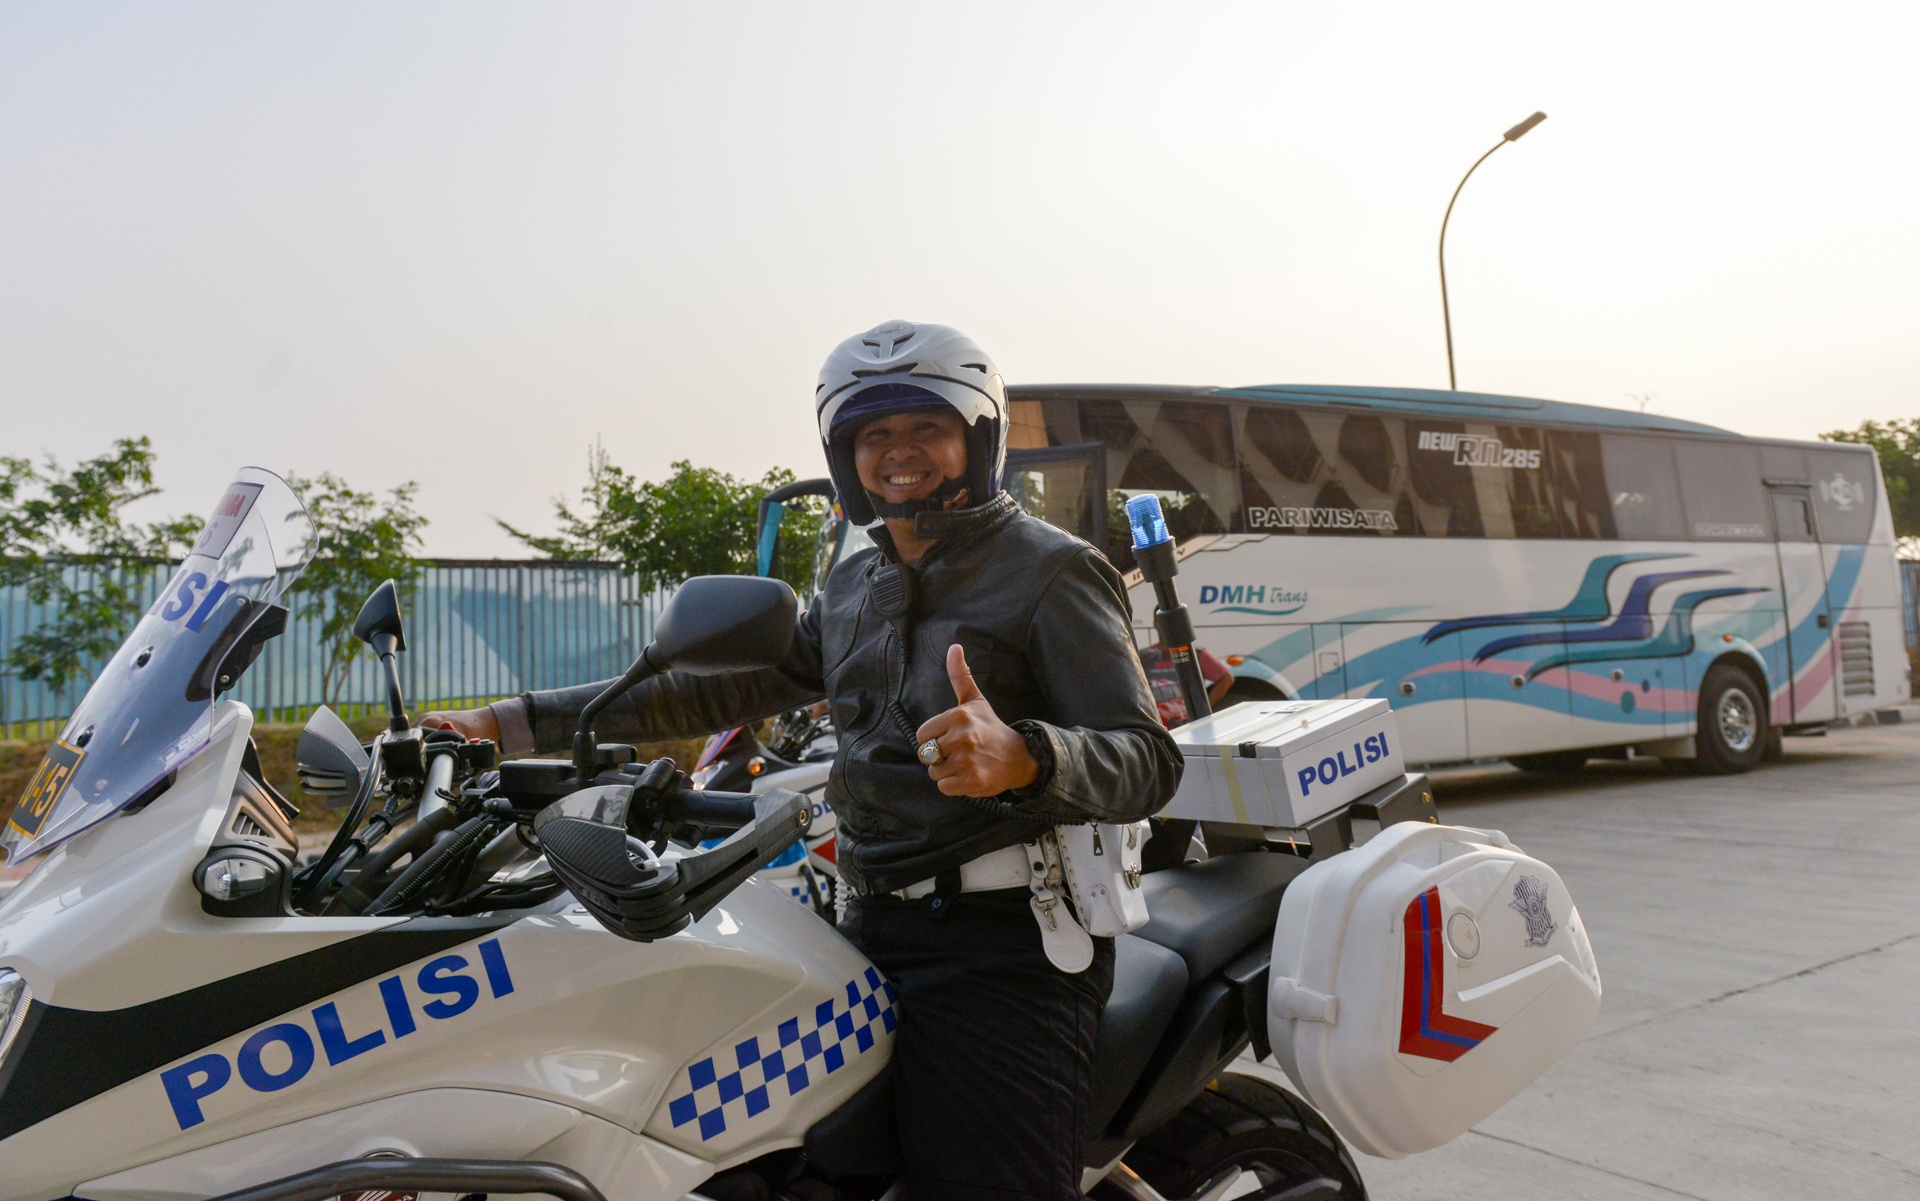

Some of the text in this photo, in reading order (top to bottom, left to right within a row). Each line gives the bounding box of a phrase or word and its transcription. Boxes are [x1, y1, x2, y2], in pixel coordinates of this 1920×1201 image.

[1248, 507, 1398, 530] PARIWISATA
[1199, 584, 1266, 605] DMH
[1297, 731, 1390, 797] POLISI
[159, 937, 514, 1131] POLISI
